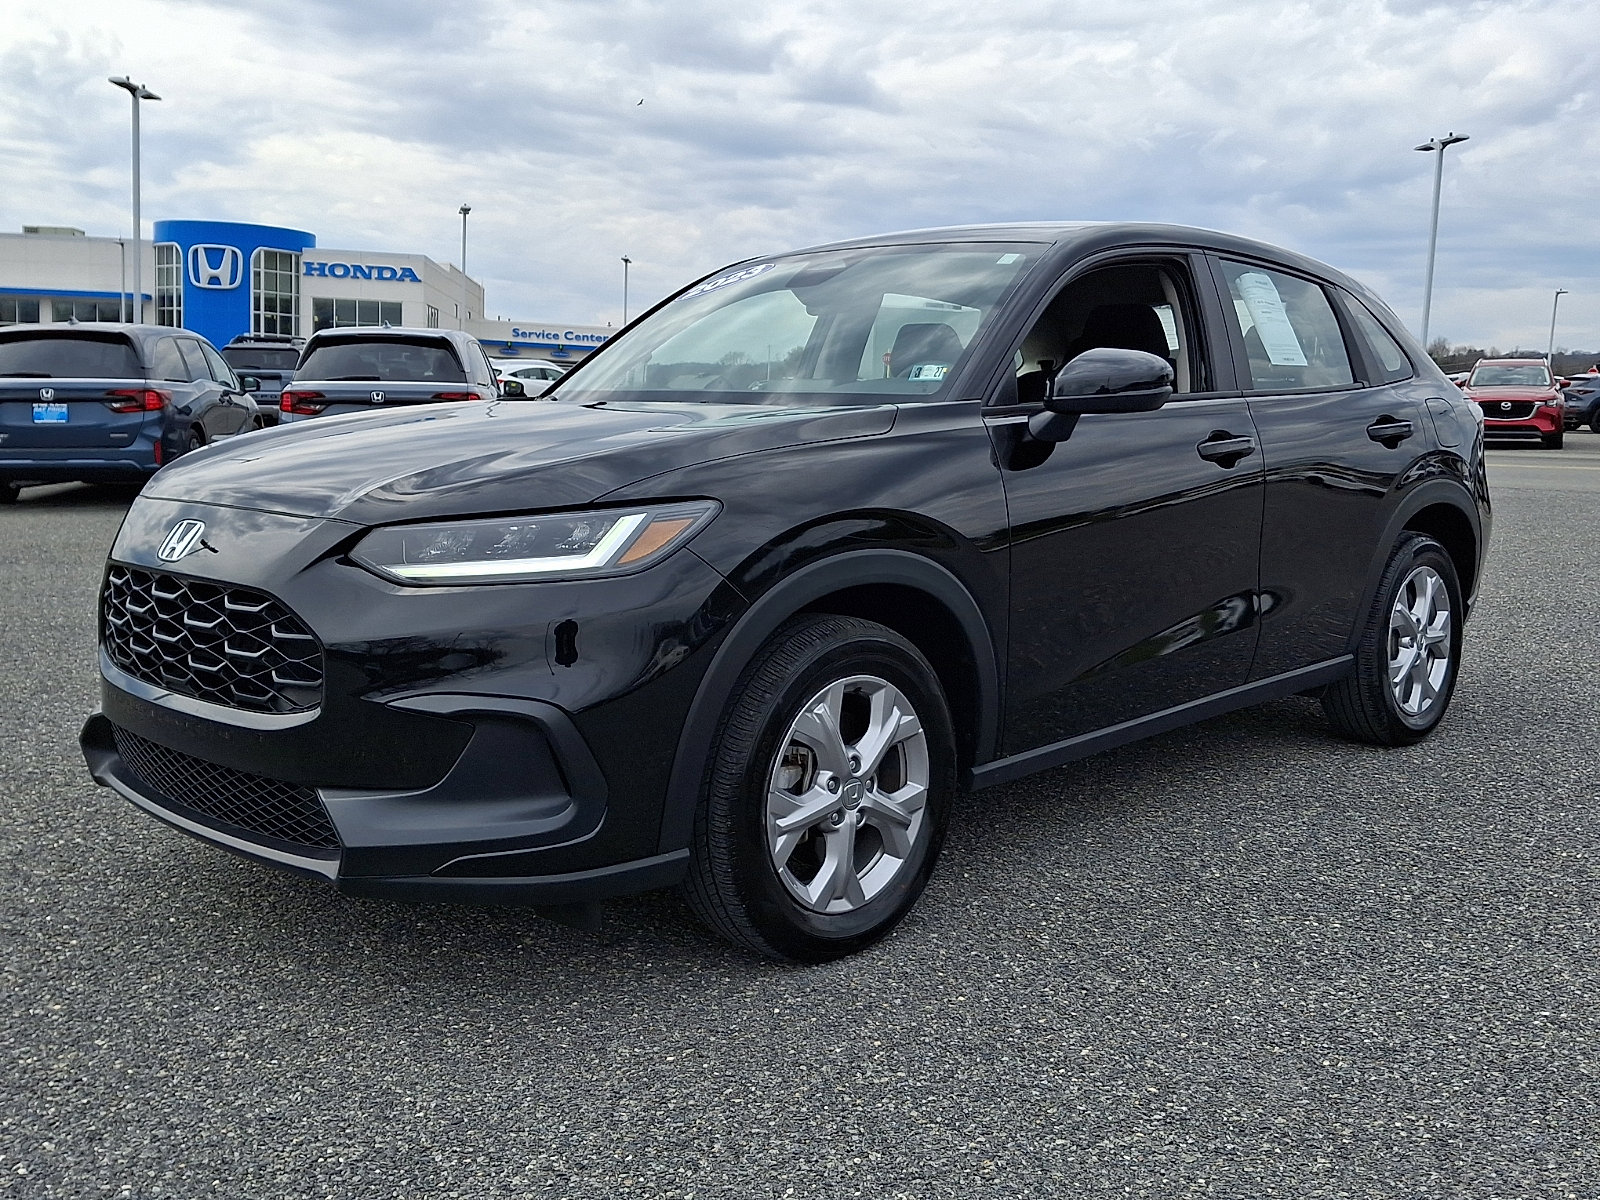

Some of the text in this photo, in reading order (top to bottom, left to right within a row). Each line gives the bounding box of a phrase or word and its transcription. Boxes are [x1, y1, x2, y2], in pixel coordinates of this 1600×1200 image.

[303, 261, 422, 283] HONDA
[681, 264, 765, 300] 2023
[512, 328, 609, 343] Service Center
[915, 366, 922, 378] 3
[934, 367, 944, 377] 27
